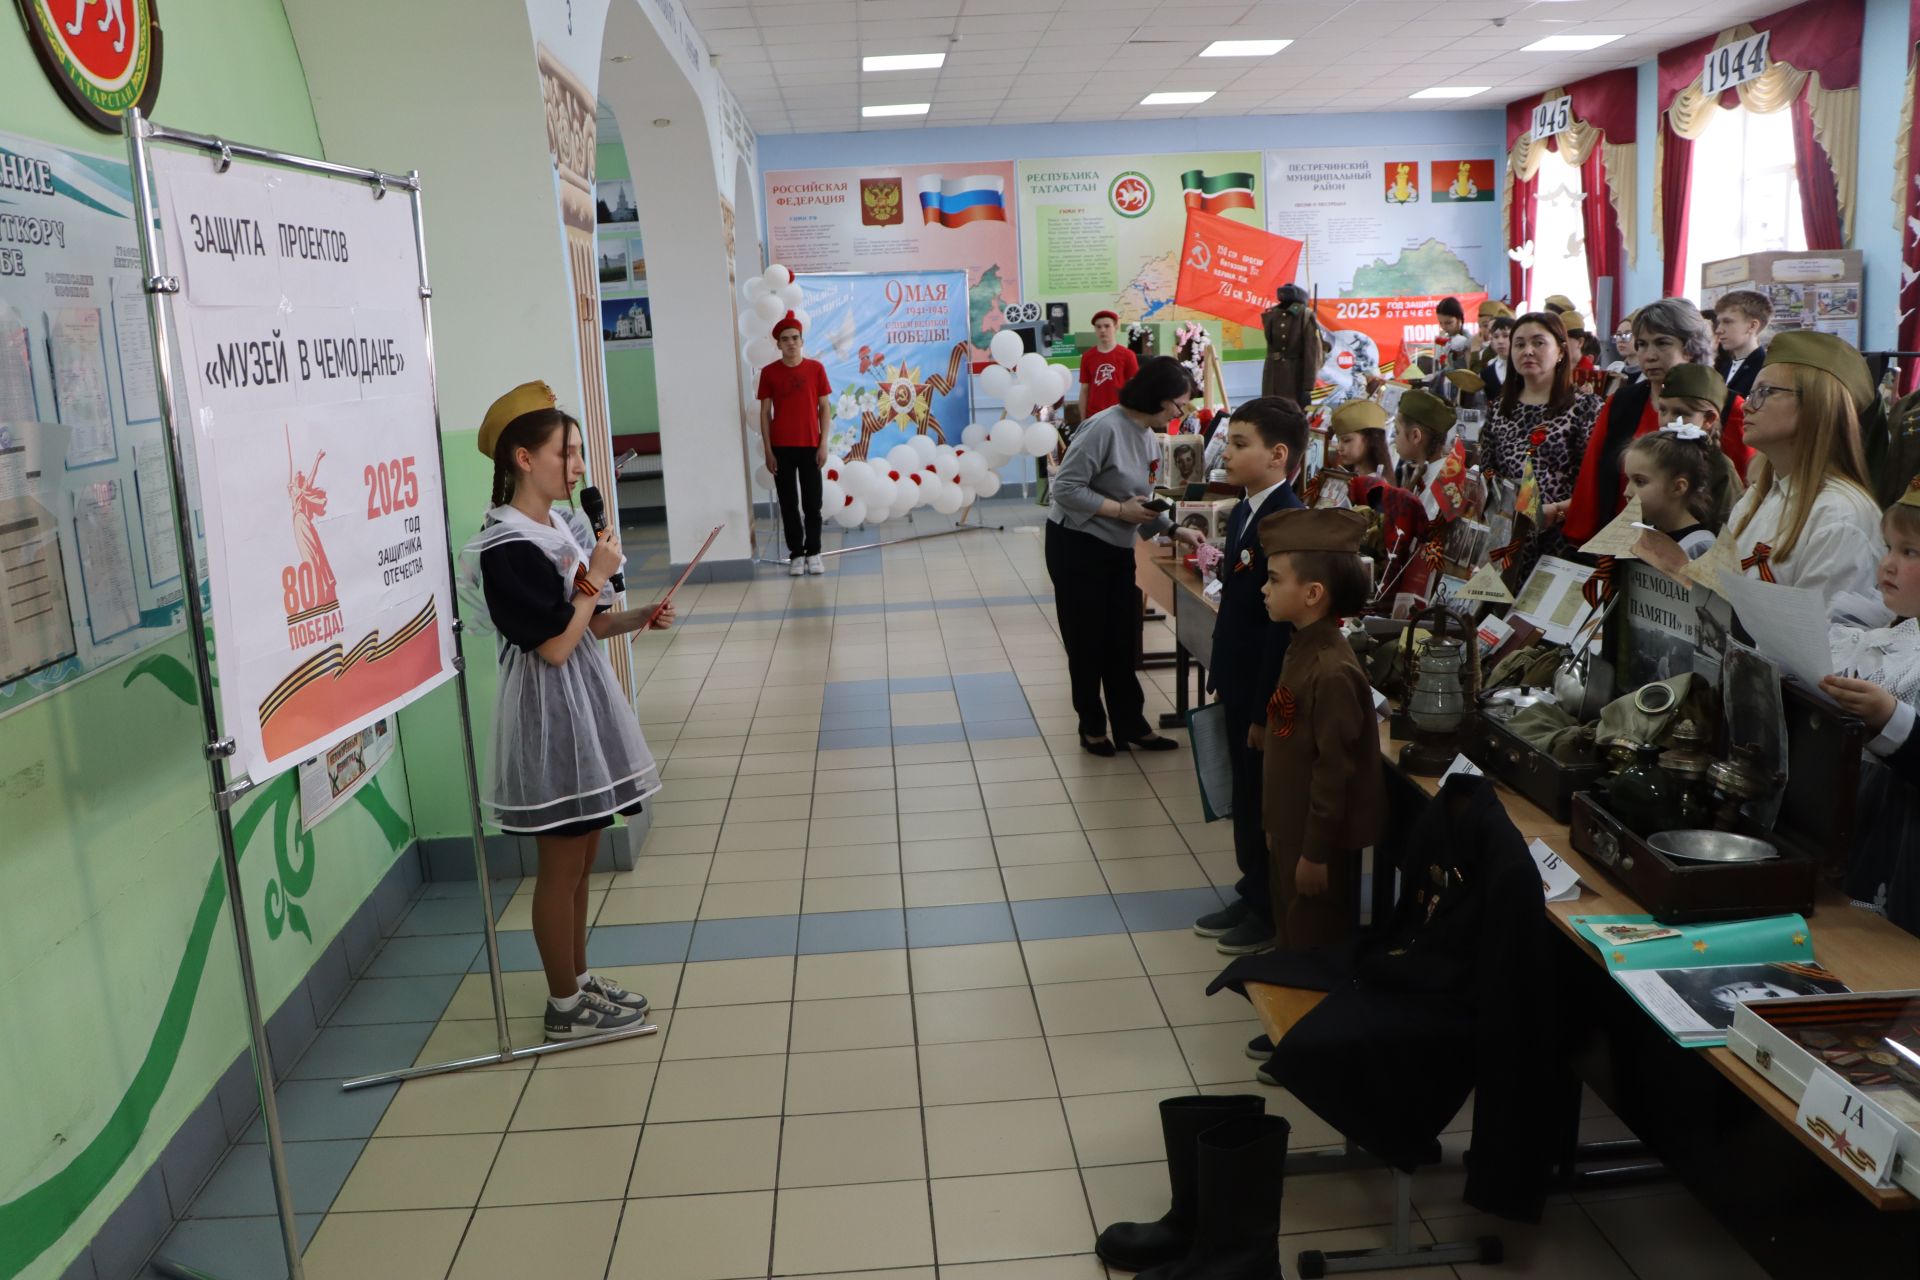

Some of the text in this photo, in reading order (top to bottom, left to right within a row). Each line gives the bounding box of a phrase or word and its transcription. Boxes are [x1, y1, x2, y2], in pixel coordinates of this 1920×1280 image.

[1708, 35, 1765, 93] 1944
[68, 65, 136, 109] ТАТАРСТАН
[1533, 100, 1568, 139] 1945
[1286, 170, 1372, 182] МУНИЦИПАЛЬНЫЙ
[1288, 160, 1369, 172] ПЕСТРЕЧИНСКИЙ
[1027, 171, 1100, 183] РЕСПУБЛИКА
[1313, 182, 1346, 191] РАЙОН
[772, 181, 848, 194] РОССИЙСКАЯ
[1030, 183, 1097, 194] ТАТАРСТАН
[776, 195, 845, 207] ФЕДЕРАЦИЯ
[190, 214, 349, 262] ЗАЩИТА ПРОЕКТОВ
[885, 279, 948, 317] 9 МАЯ
[905, 305, 949, 316] 1941-1945
[1336, 300, 1440, 319] 2025 ГОД ЗАЩИТН
[1386, 309, 1436, 318] ОТЕЧЕС
[886, 329, 950, 344] ПОБЕДЫ!
[205, 329, 289, 388] «МУЗЕЙ
[297, 339, 311, 381] В
[314, 338, 405, 384] ЧЕМОДАНЕ»
[364, 456, 419, 520] 2025
[404, 515, 421, 535] ГОД
[378, 536, 422, 567] ЗАЩИТНИКА
[383, 557, 424, 586] ОТЕЧЕСТВА
[1630, 598, 1682, 630] ПАМЯТИ»
[288, 610, 344, 650] ПОБЕДА!
[1543, 852, 1563, 871] 1Б
[1840, 1094, 1864, 1129] 1А
